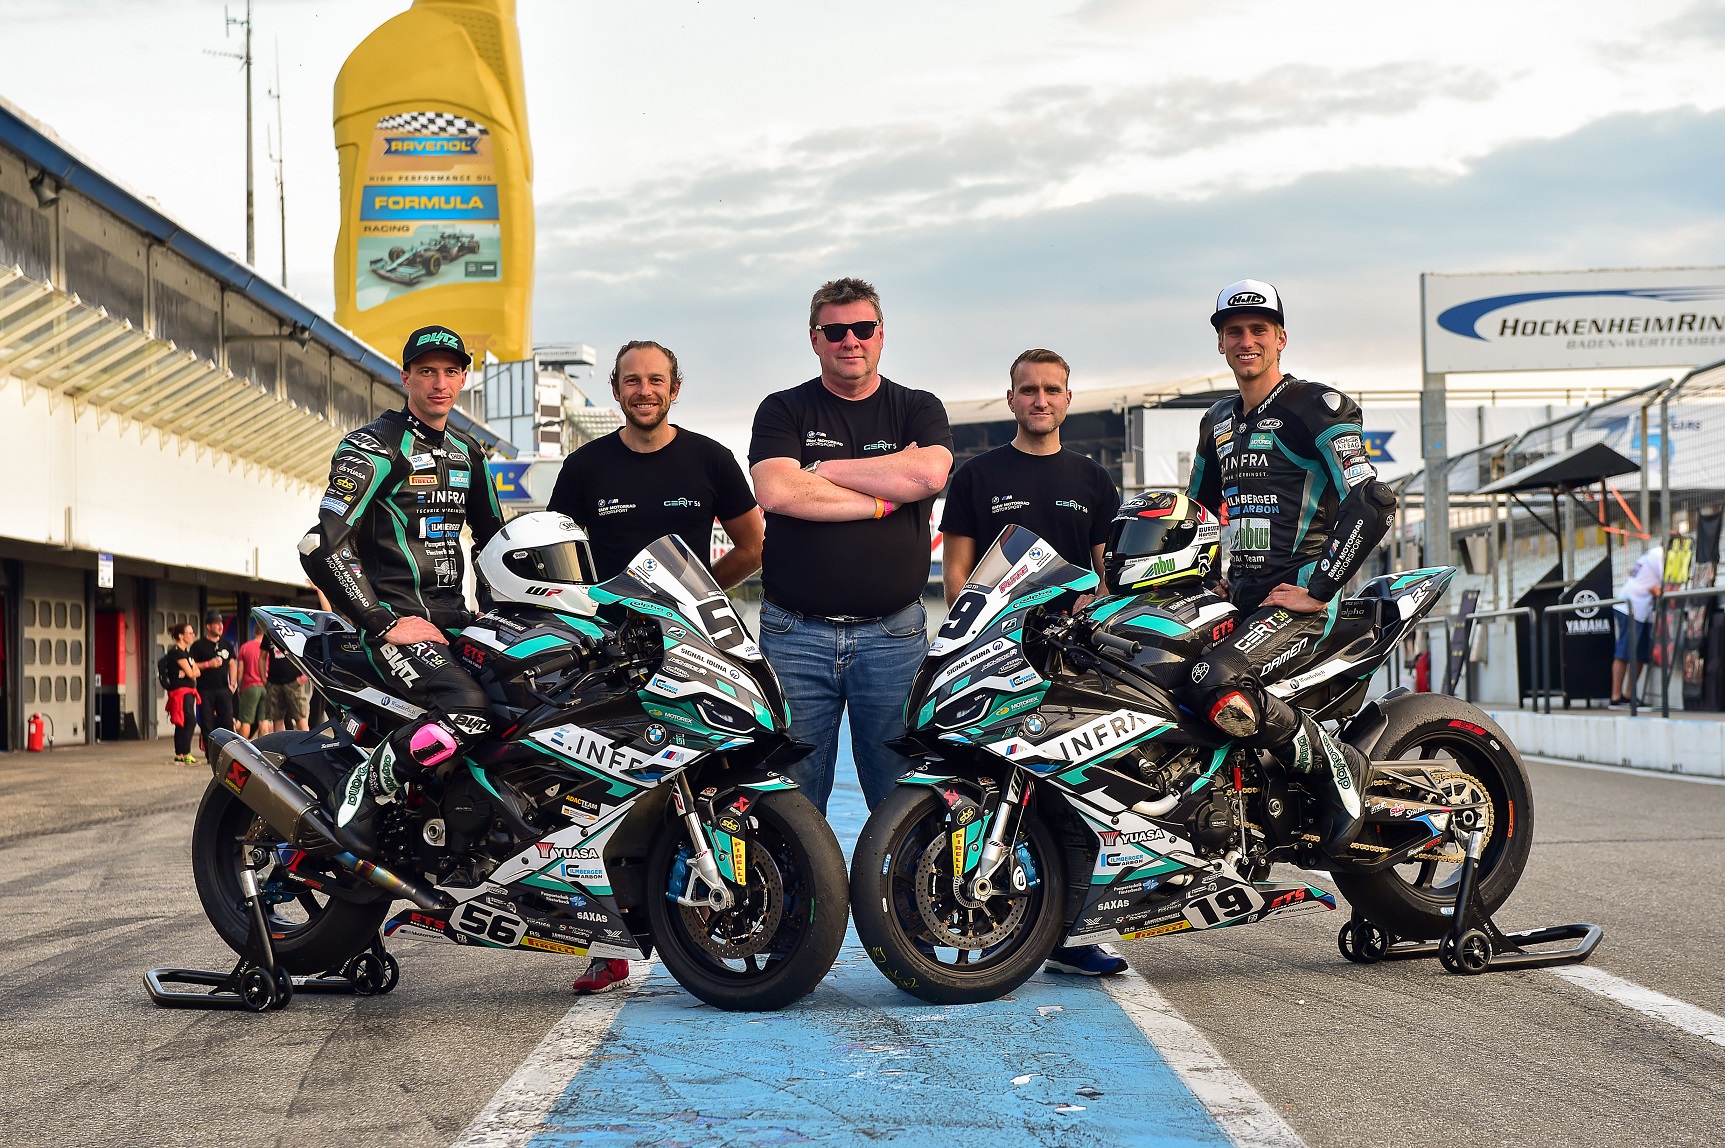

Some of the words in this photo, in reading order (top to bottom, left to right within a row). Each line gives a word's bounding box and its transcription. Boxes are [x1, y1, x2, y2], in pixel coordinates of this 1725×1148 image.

[390, 140, 471, 152] RAVENOL
[374, 196, 484, 210] FORMULA
[1230, 295, 1262, 304] HJC
[416, 330, 459, 349] BLITZ
[1327, 560, 1342, 579] BMW
[1340, 518, 1364, 562] MOTORRAD
[1152, 556, 1176, 575] nbw
[1243, 554, 1265, 563] Team
[1333, 535, 1364, 582] MOTORSPORT
[324, 556, 358, 601] MOTORSPORT
[331, 553, 346, 570] BMW
[342, 569, 370, 608] MOTORRAD
[938, 592, 988, 641] 9
[1273, 610, 1289, 621] 56
[1341, 608, 1365, 617] alpha
[696, 599, 745, 650] 5
[1212, 618, 1234, 641] ETS
[1566, 619, 1611, 633] YAMAHA
[463, 643, 486, 664] ETS
[680, 648, 706, 662] SIGNAL
[706, 659, 728, 673] IDUNA
[946, 659, 970, 677] SIGNAL
[969, 648, 991, 664] IDUNA
[379, 643, 422, 689] BLITZ
[1010, 696, 1039, 710] MOTOREX
[664, 712, 693, 723] MOTOREX
[721, 819, 738, 831] sbs
[960, 808, 974, 824] sbs
[1120, 829, 1165, 845] YUASA
[554, 848, 600, 860] YUASA
[734, 841, 742, 883] PIRELLI
[955, 833, 963, 876] PIRELLI
[1097, 900, 1130, 911] SAXAS
[1188, 886, 1253, 925] 19
[1271, 886, 1306, 908] ETS
[410, 912, 446, 930] ETS
[459, 902, 521, 945] 56
[576, 911, 608, 923] SAXAS
[1134, 921, 1184, 939] PIRELLI
[527, 938, 576, 955] PIRELLI
